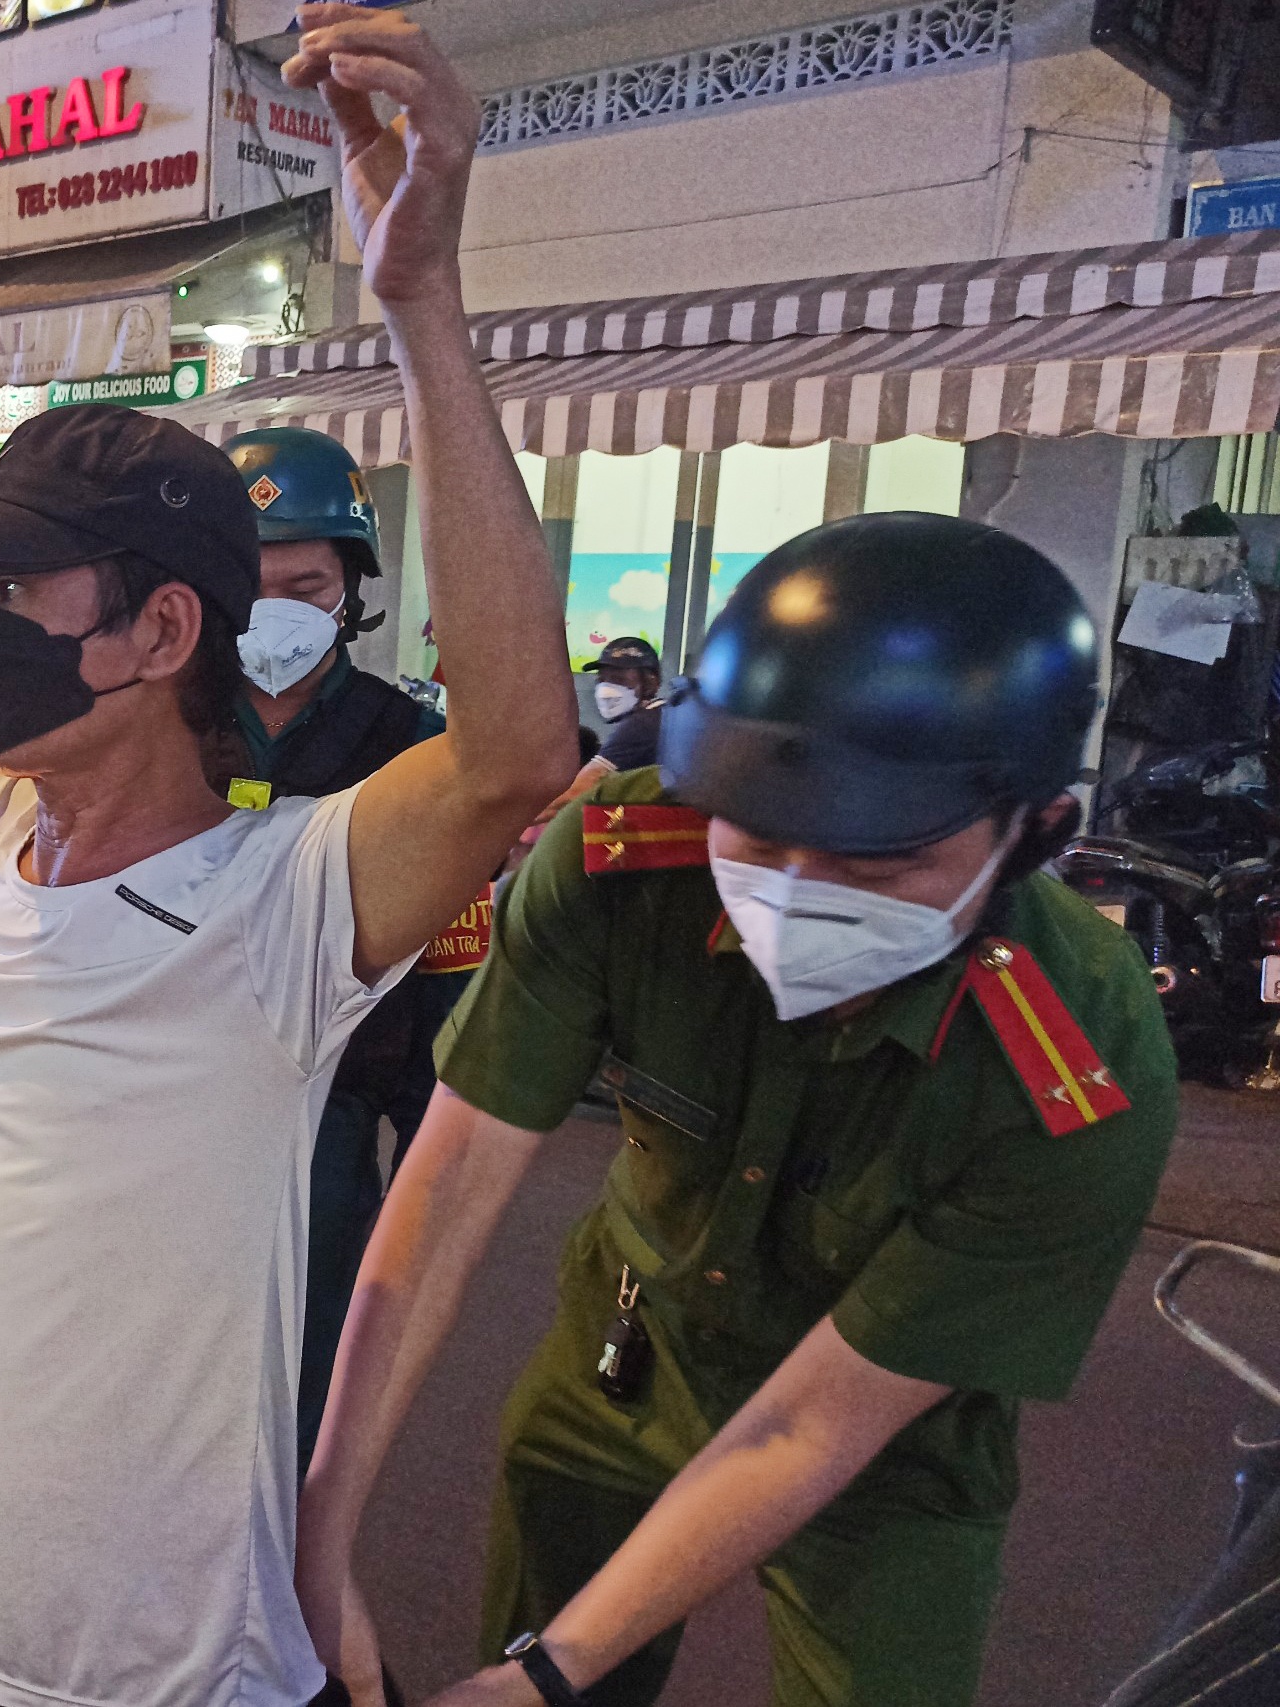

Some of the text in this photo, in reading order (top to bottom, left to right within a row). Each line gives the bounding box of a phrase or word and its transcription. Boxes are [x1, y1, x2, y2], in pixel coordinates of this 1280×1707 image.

[268, 102, 333, 148] MAHAL
[237, 141, 317, 178] RESTAURANT
[52, 375, 171, 403] JOY OUR DELICIOUS FOOD
